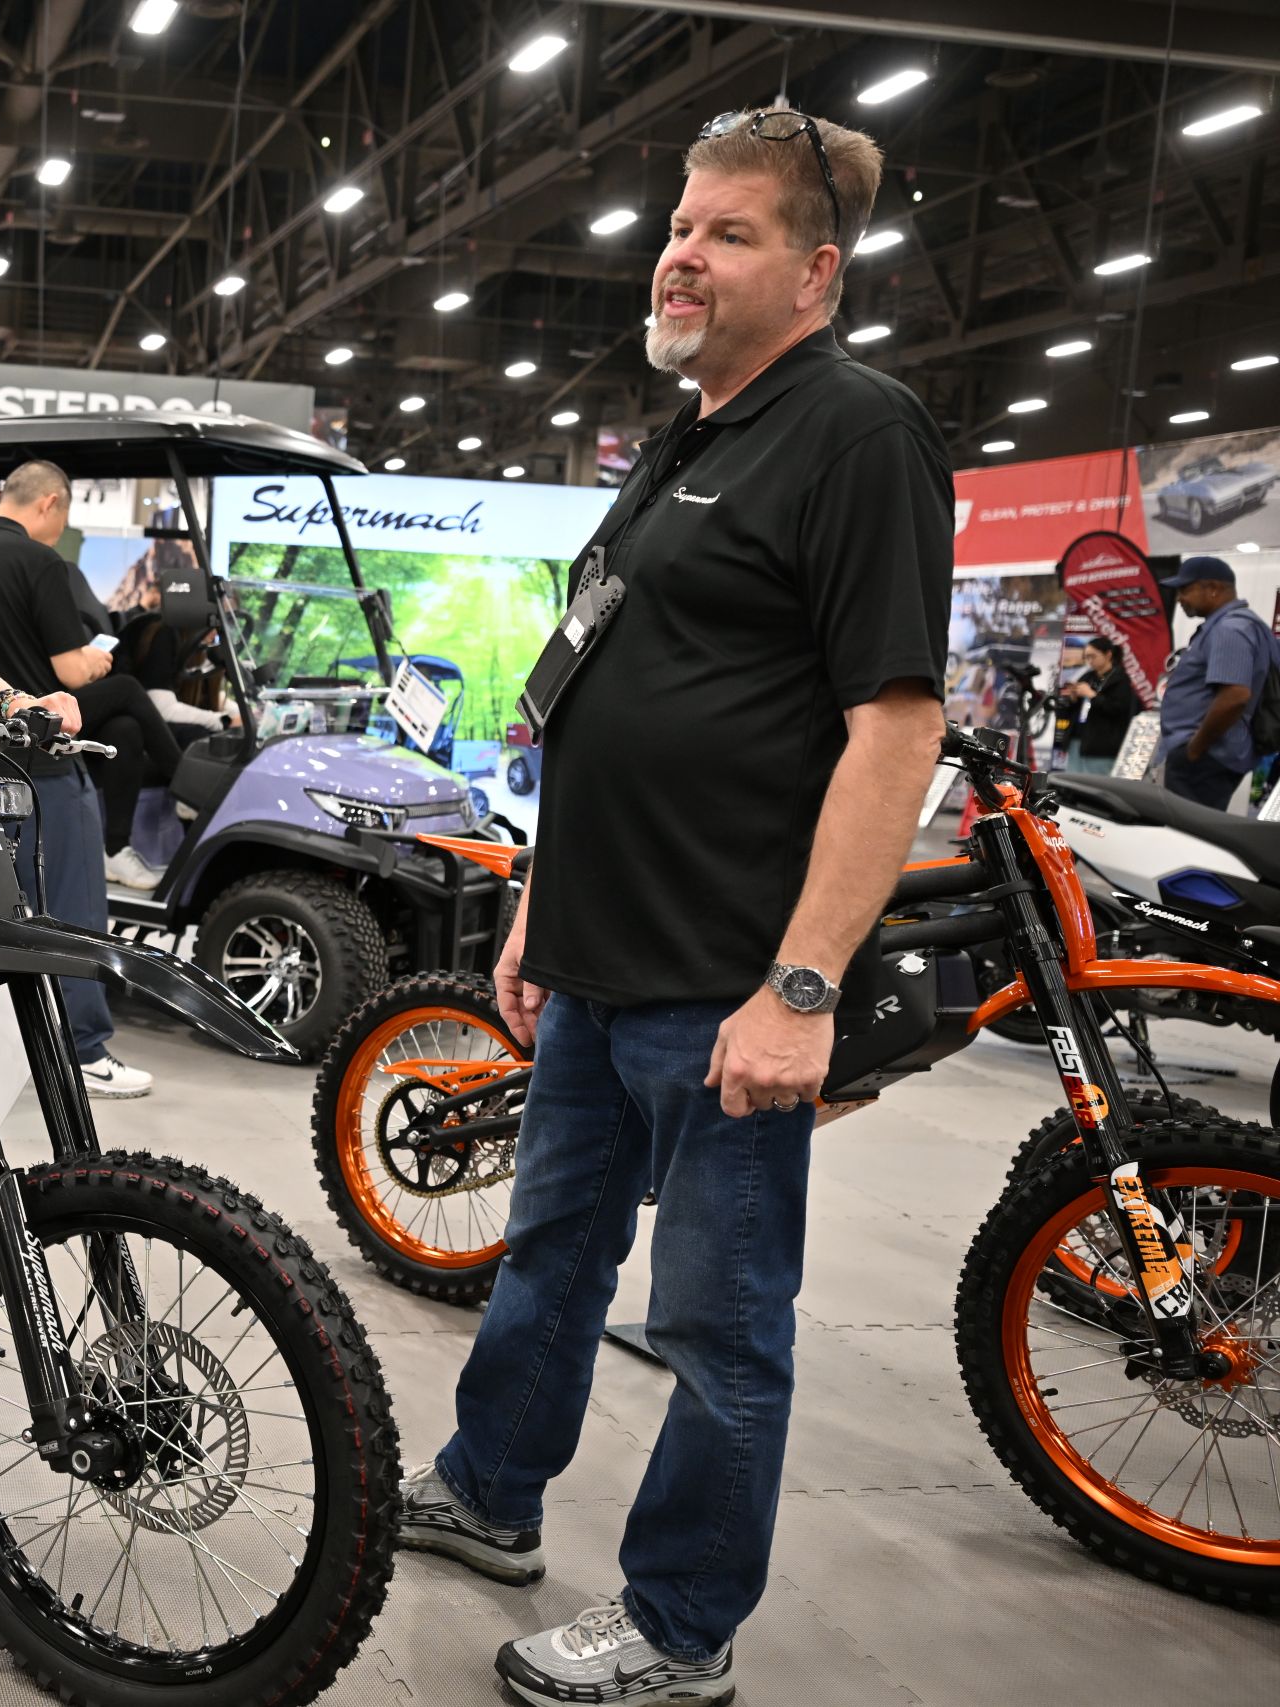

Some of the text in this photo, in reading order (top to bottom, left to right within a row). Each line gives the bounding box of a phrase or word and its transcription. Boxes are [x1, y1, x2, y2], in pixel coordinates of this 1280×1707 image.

[1021, 501, 1073, 517] PROTECT
[1070, 816, 1102, 831] META
[1134, 901, 1209, 932] Supermach
[1115, 1176, 1170, 1273] EXTREME
[24, 1230, 69, 1354] Supermach
[24, 1266, 48, 1348] ELECTRIC POWER
